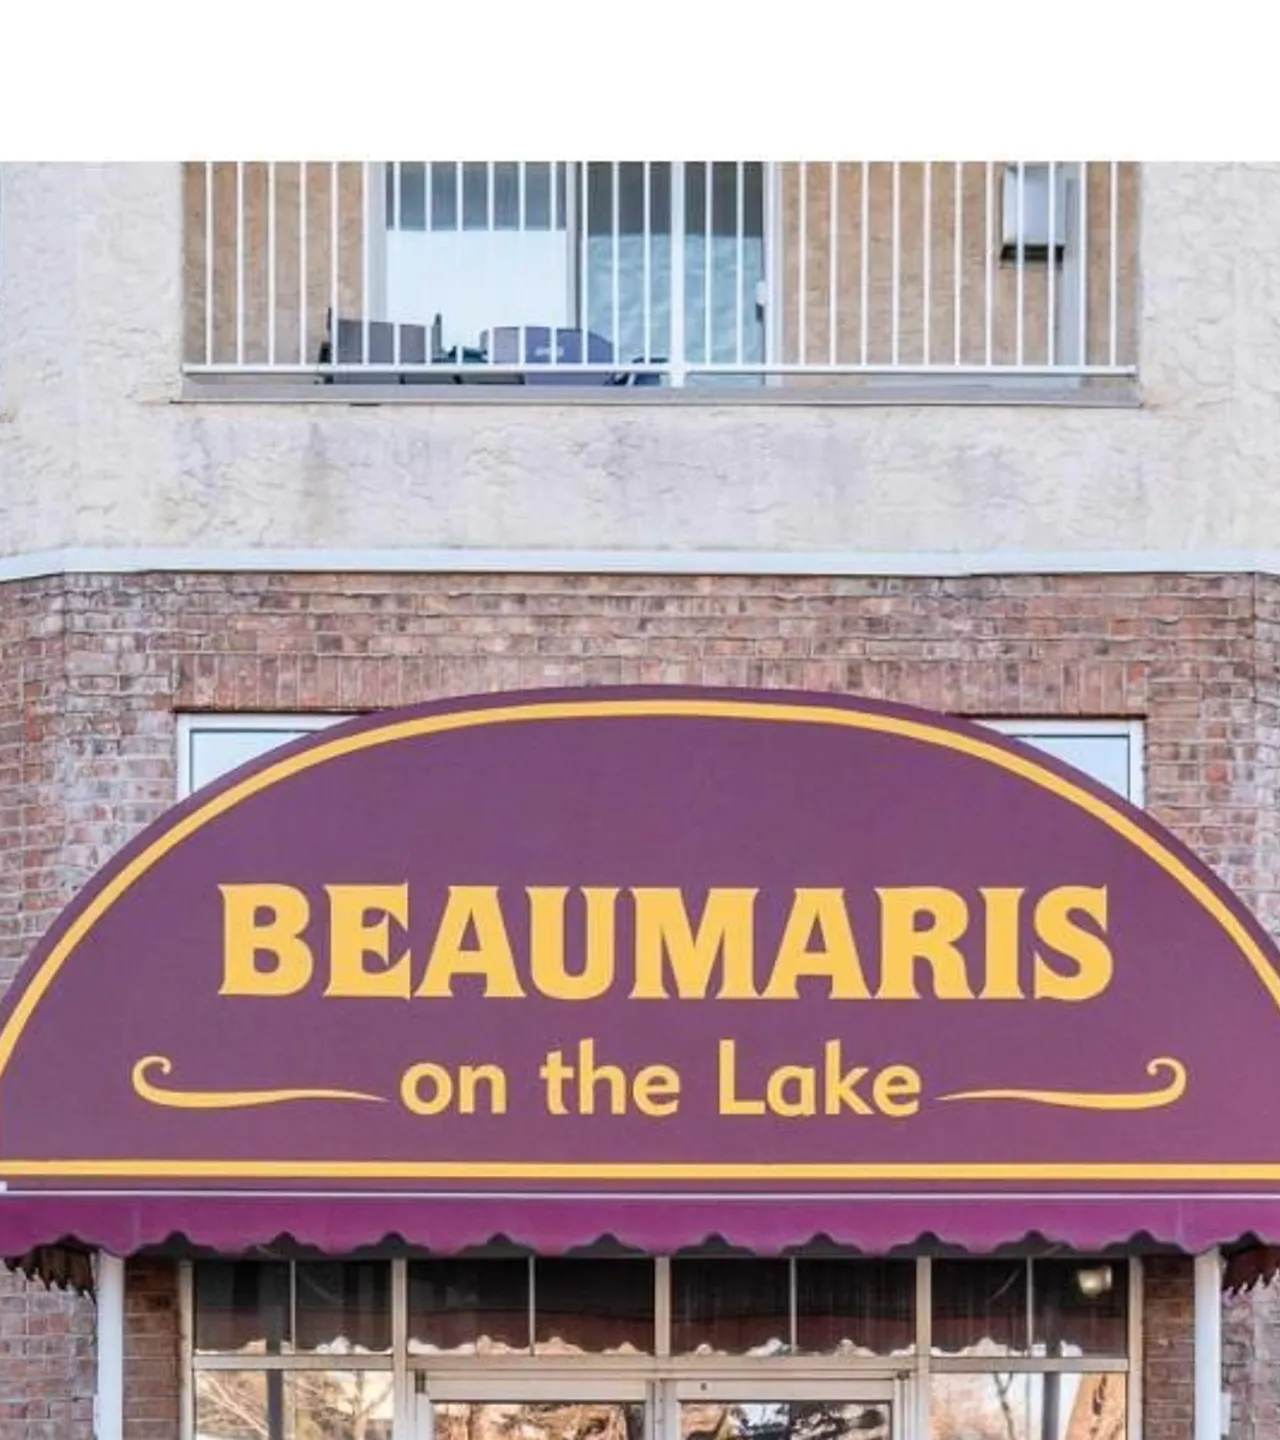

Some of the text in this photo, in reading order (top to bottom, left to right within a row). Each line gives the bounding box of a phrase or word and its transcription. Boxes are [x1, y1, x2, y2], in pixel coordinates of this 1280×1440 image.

[220, 882, 1114, 1001] BEAUMARIS
[398, 1037, 923, 1119] on the Lake
